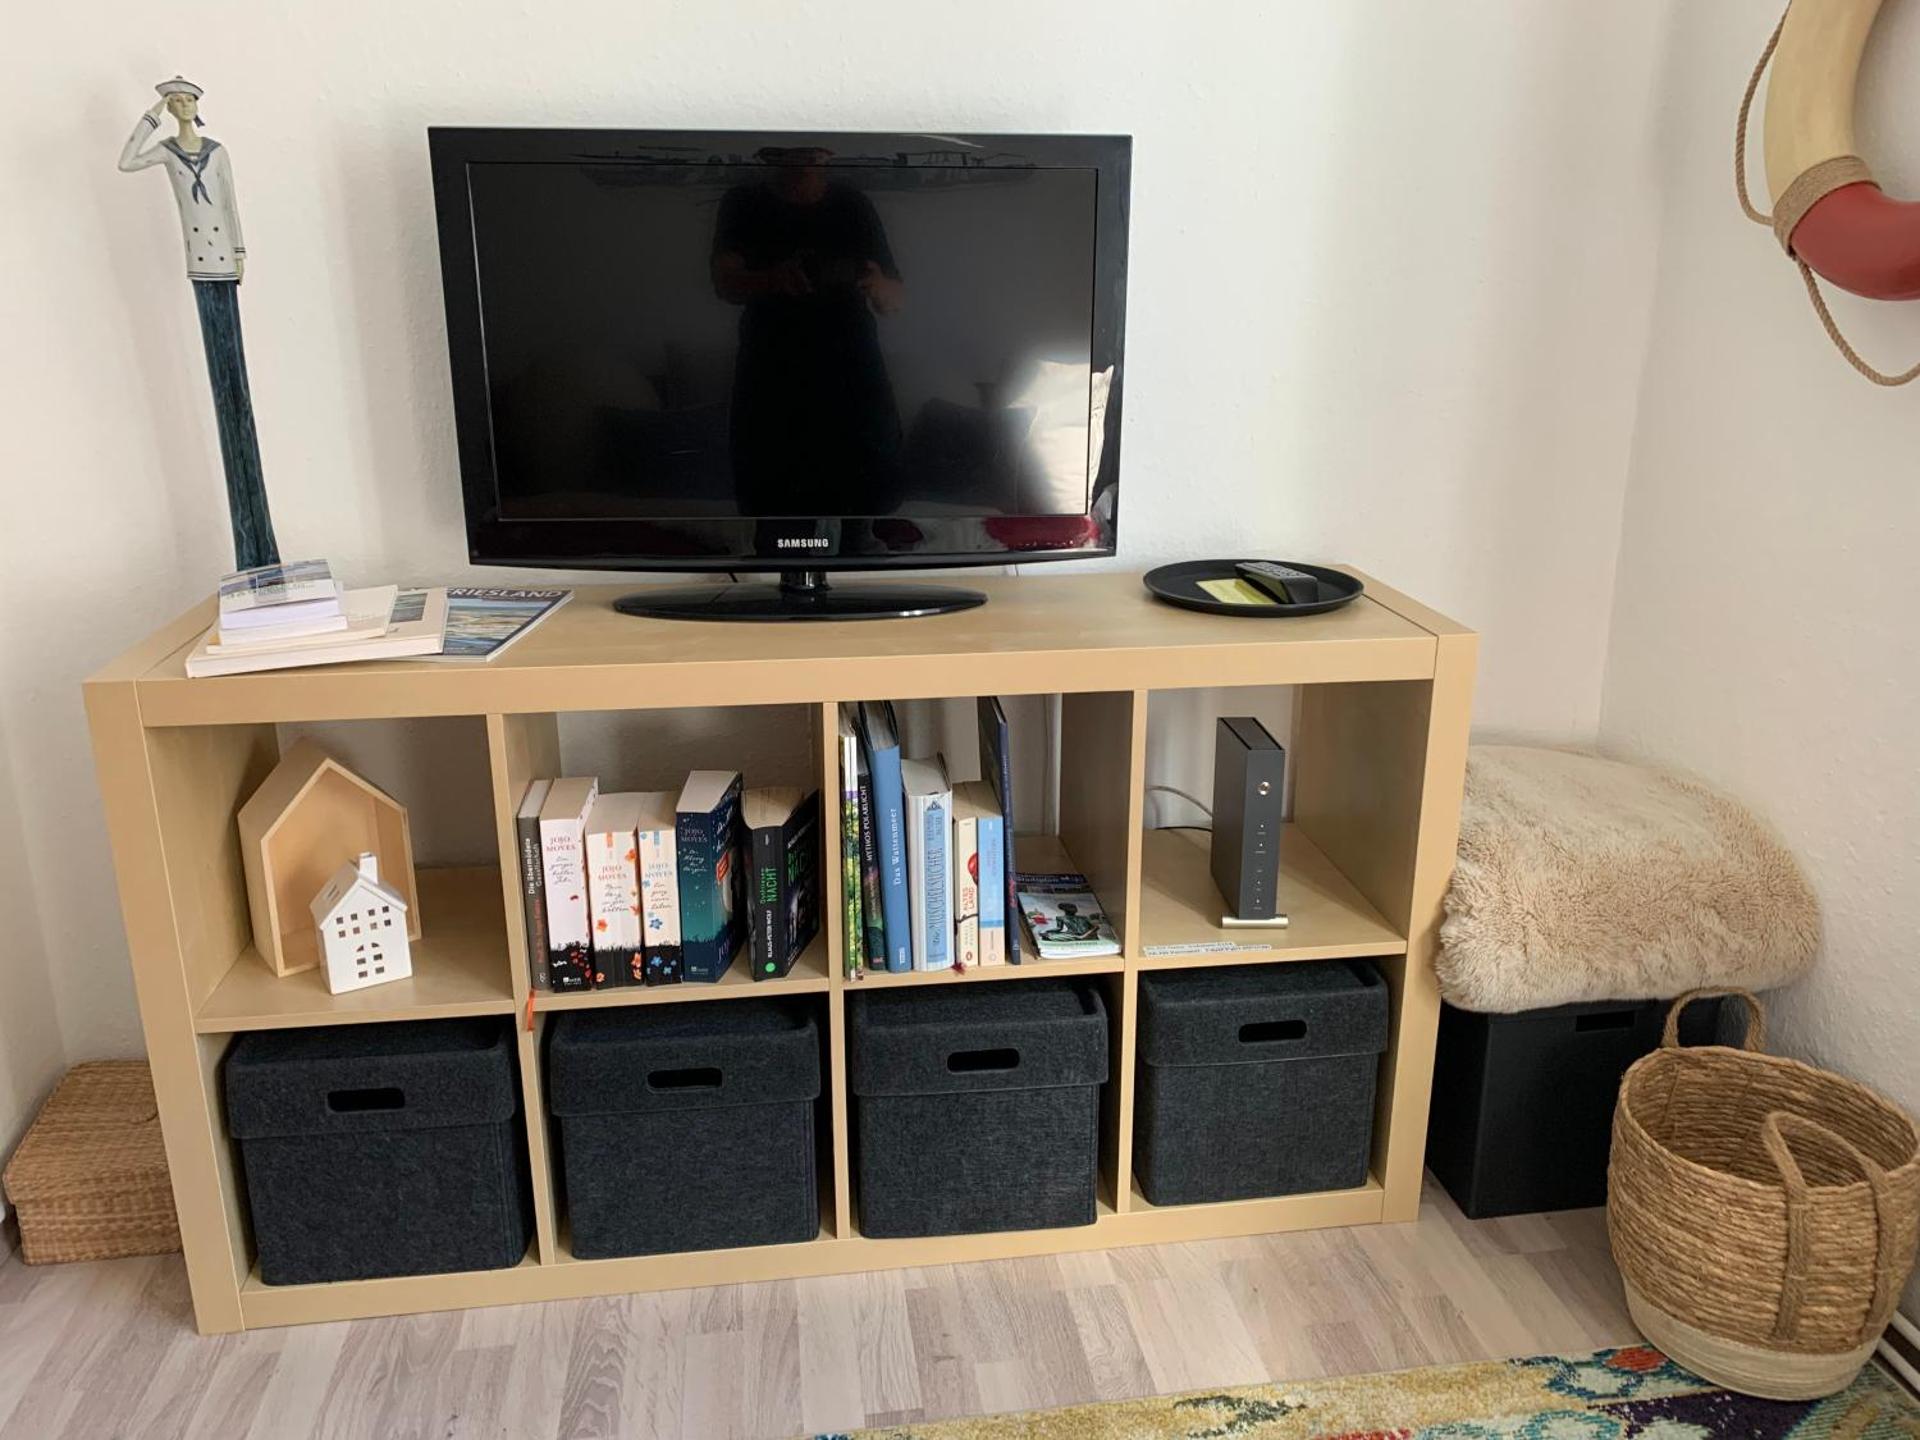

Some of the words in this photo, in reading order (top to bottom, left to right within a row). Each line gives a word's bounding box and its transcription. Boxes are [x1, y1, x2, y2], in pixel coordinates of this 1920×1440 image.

[777, 538, 829, 549] SAMSUNG
[864, 831, 873, 861] MYTHOS
[890, 808, 900, 864] Wattenmeer
[765, 868, 778, 902] NACHT
[893, 868, 901, 885] Das
